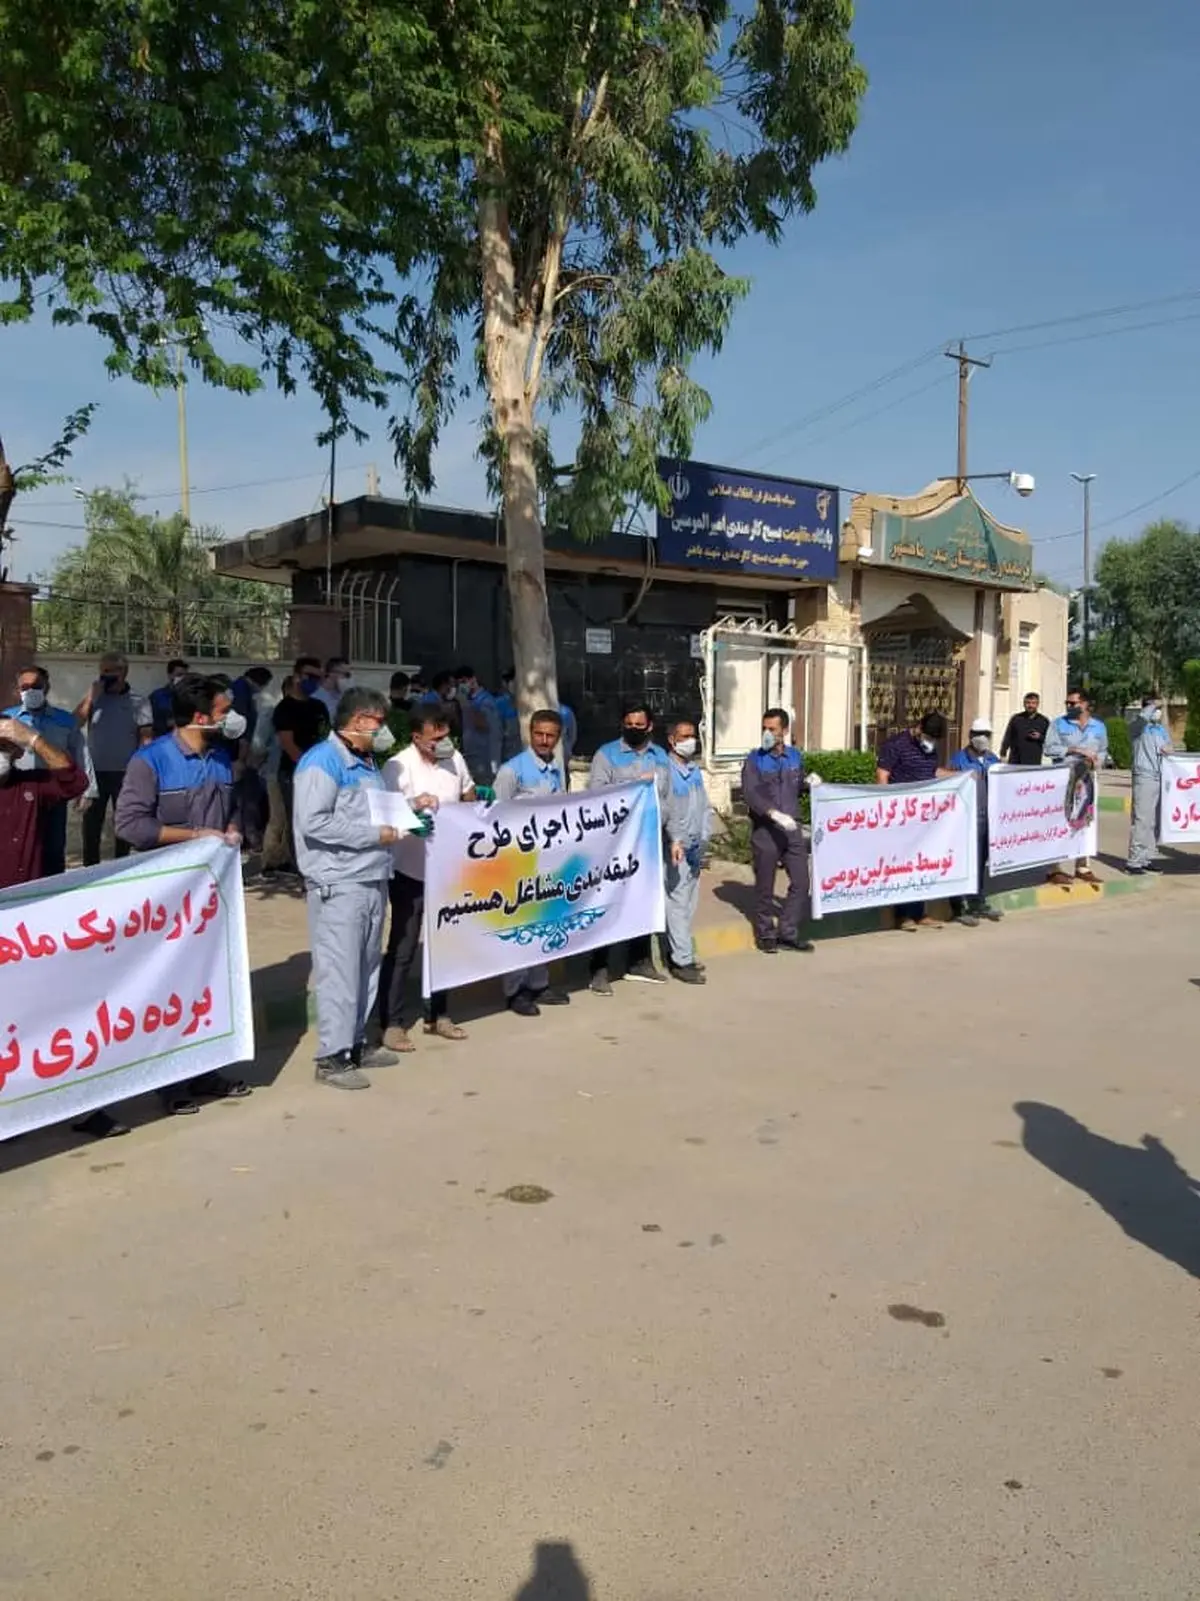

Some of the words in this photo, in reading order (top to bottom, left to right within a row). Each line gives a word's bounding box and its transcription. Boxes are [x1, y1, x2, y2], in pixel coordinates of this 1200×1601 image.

[762, 525, 783, 543] بسیج
[783, 524, 814, 546] مقاومت
[813, 527, 834, 552] پایگاه
[889, 540, 926, 562] ماهشهر
[575, 799, 630, 843] خواستار
[826, 808, 866, 833] بومی
[868, 795, 919, 830] کارگران
[920, 793, 957, 822] اخراج
[467, 821, 513, 859] طرح
[517, 809, 569, 853] اجرای
[603, 854, 640, 883] طبقه
[820, 866, 860, 891] بومی
[915, 849, 954, 876] توسط
[123, 881, 220, 941] قرارداد
[437, 890, 505, 930] هستیم
[504, 877, 565, 916] مشاغل
[63, 909, 117, 953] یک
[143, 986, 214, 1036] برده
[32, 1001, 136, 1080] داری
